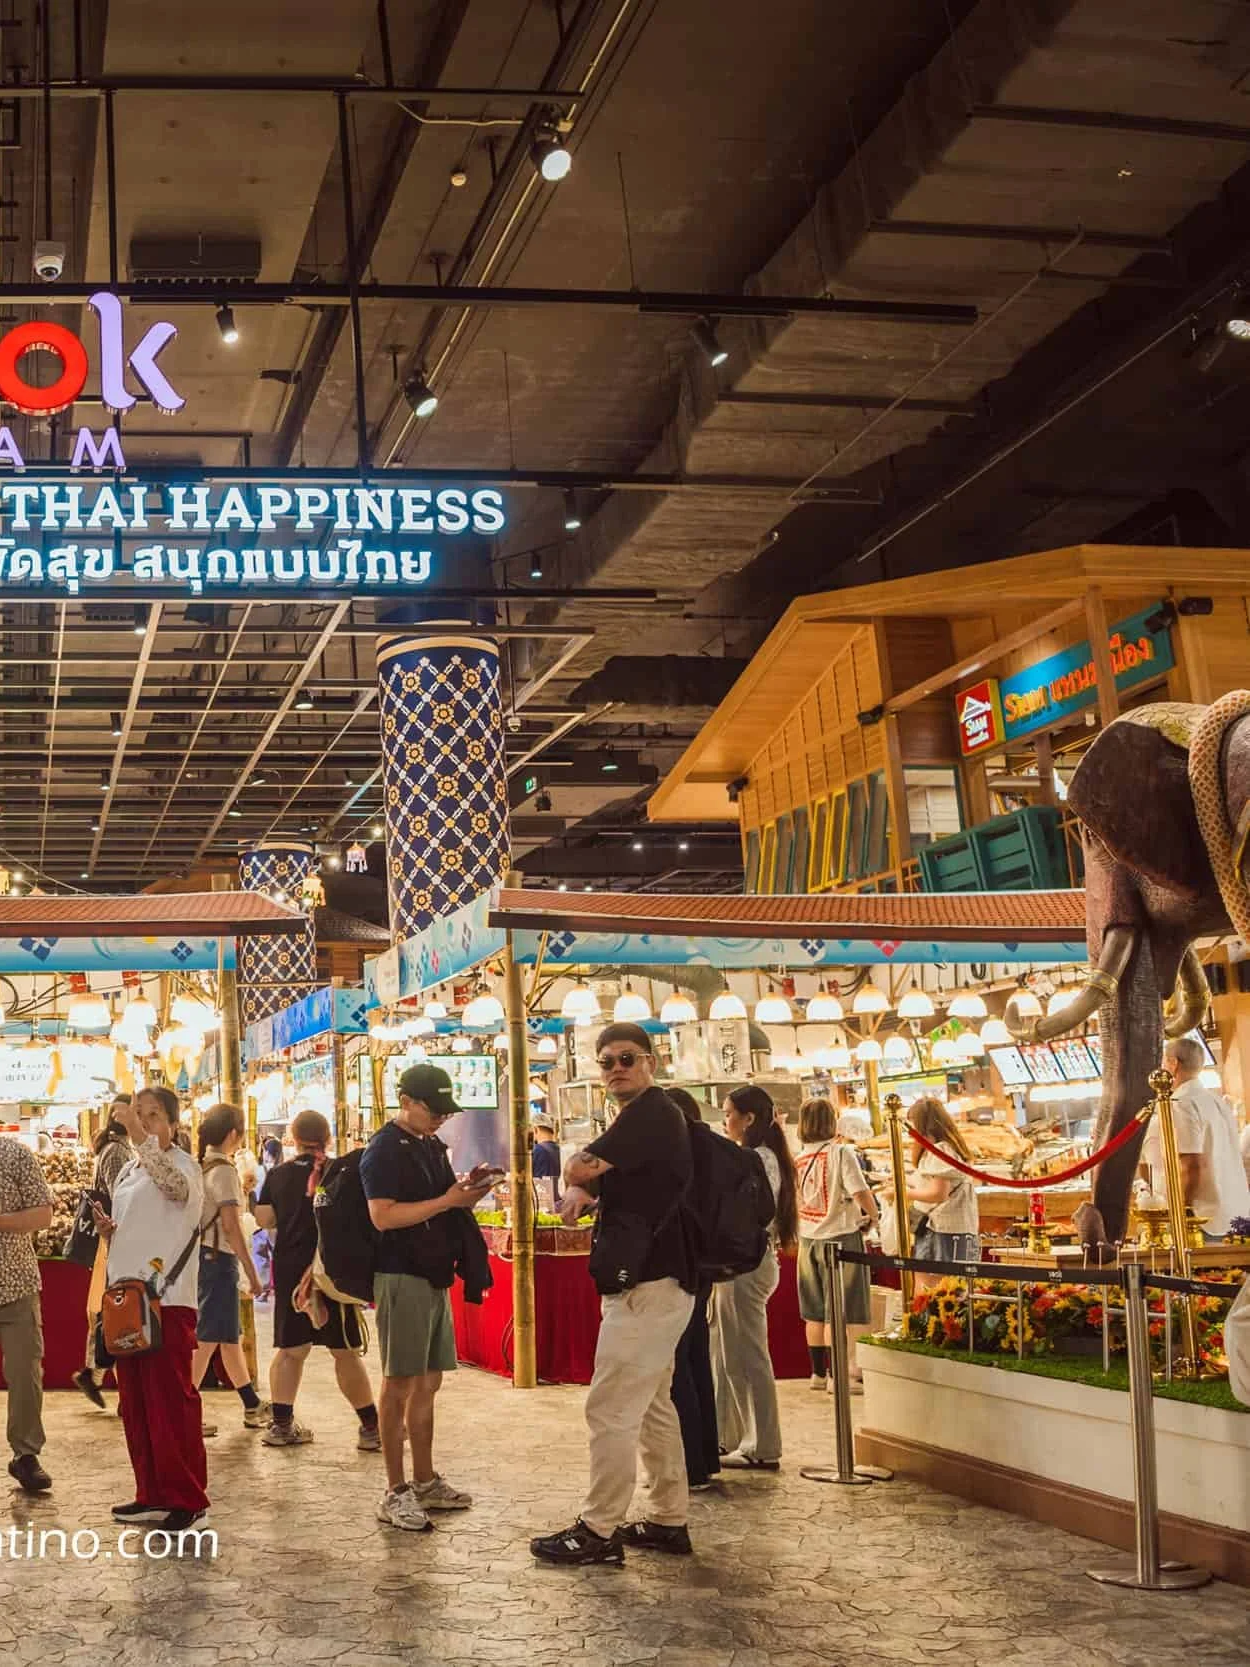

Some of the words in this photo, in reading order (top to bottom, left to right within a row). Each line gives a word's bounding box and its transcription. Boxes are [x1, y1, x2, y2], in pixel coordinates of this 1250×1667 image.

[2, 485, 149, 529] THAI
[164, 486, 505, 534] HAPPINESS
[133, 540, 432, 596] สนุกแบบไทย
